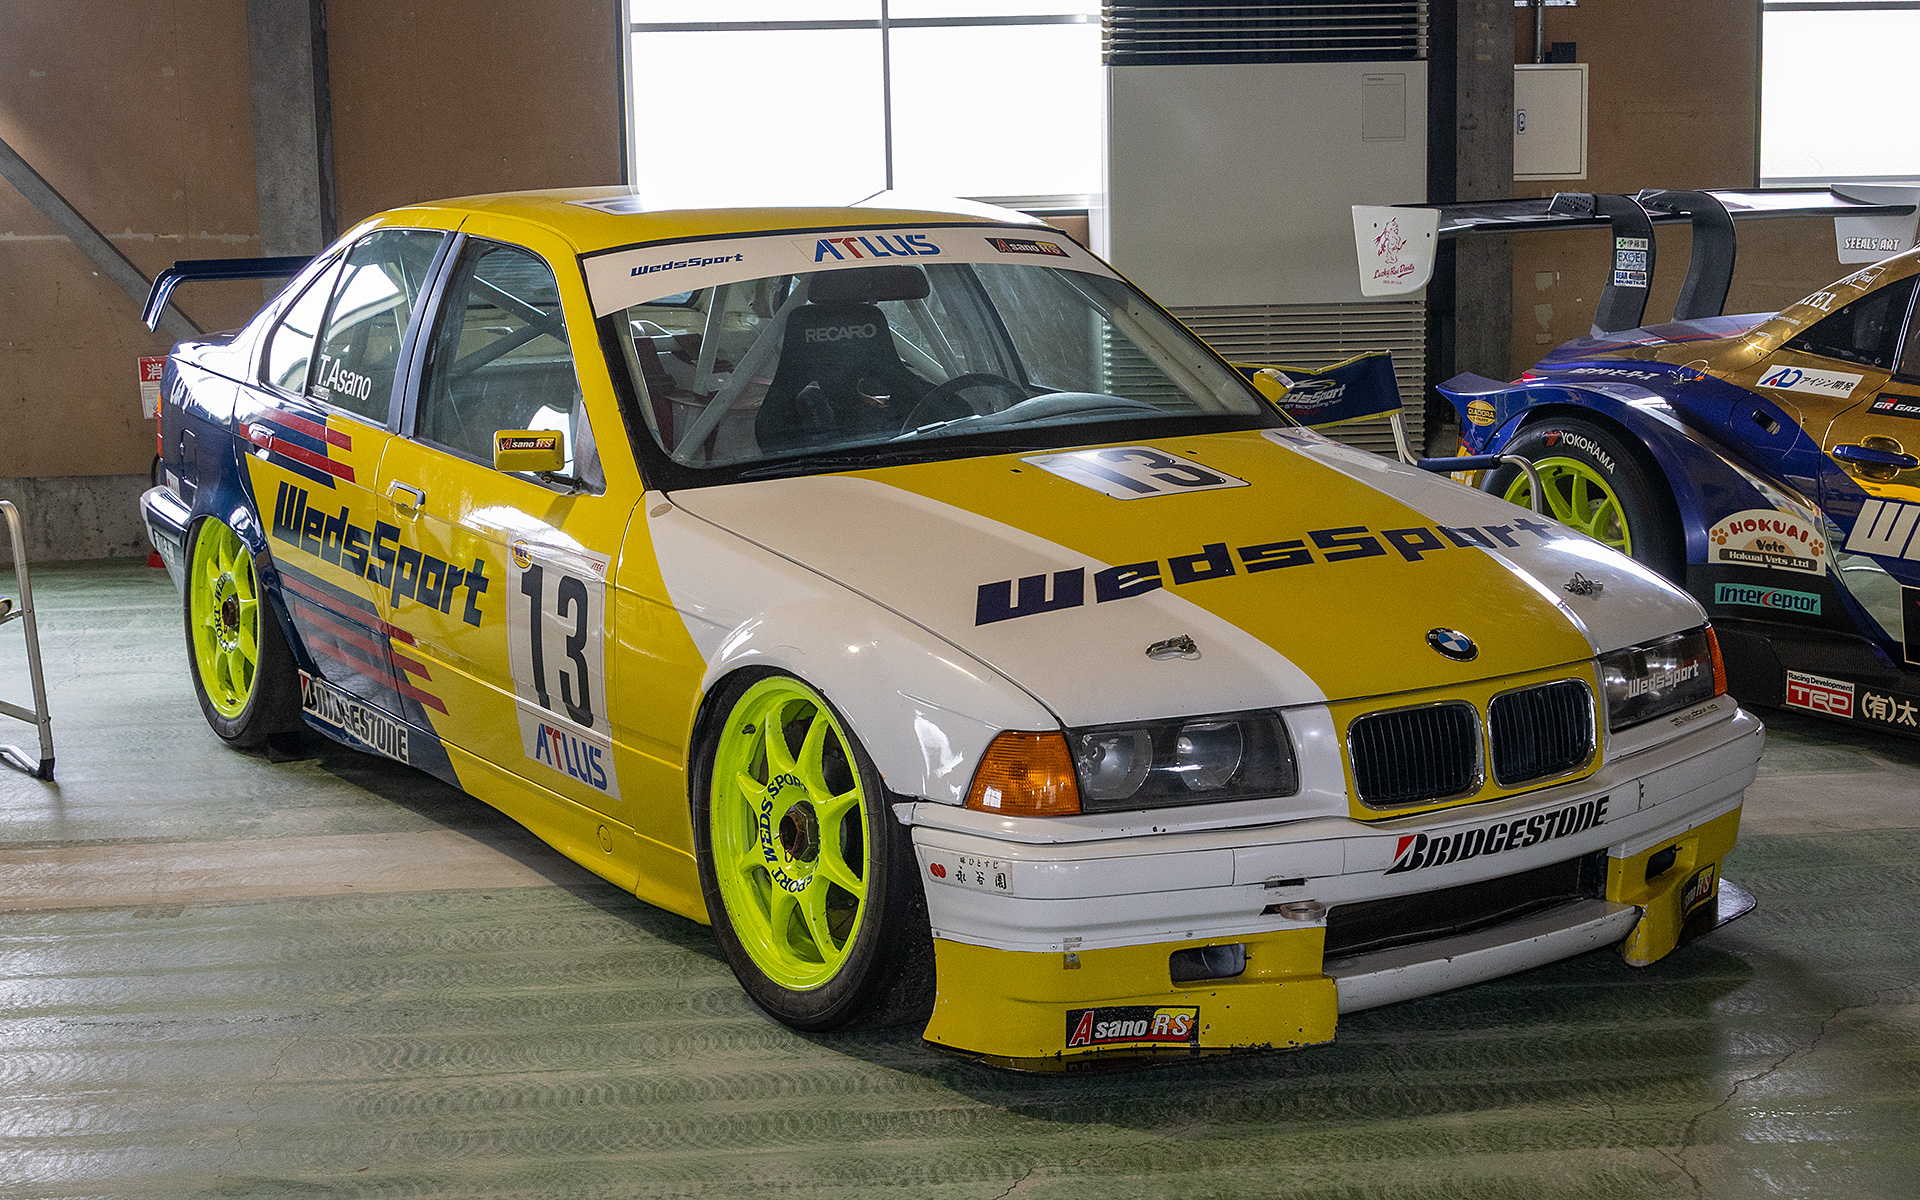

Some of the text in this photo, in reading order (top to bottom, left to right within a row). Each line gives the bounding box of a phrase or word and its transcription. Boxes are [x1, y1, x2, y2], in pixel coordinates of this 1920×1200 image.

[815, 235, 941, 262] ATLUS
[996, 238, 1040, 252] Asano
[1844, 237, 1900, 251] SEEALS ART
[630, 253, 744, 278] WedsSport
[804, 323, 877, 343] RECARO
[318, 354, 372, 401] T.Asano
[1800, 376, 1855, 392] アイシン開発
[502, 438, 535, 449] Asano
[1561, 431, 1616, 474] YOKOHAMA
[1040, 449, 1227, 493] 13
[1729, 518, 1810, 543] HOKUAI
[272, 480, 490, 628] WedsSport
[1729, 550, 1763, 562] Hokuai
[1765, 555, 1789, 566] Vets
[975, 517, 1558, 627] WedsSport
[520, 563, 595, 728] 13
[1628, 659, 1699, 699] WedsSport
[1788, 672, 1853, 693] Racing Development
[1790, 684, 1849, 713] TRD
[299, 670, 409, 764] BRIDGESTONE
[536, 722, 608, 791] ATLUS
[760, 773, 810, 864] WEDS SPORT
[1383, 796, 1610, 875] BRIDGESTONE
[955, 865, 1007, 890] 永谷園
[1068, 1010, 1148, 1047] Asano
